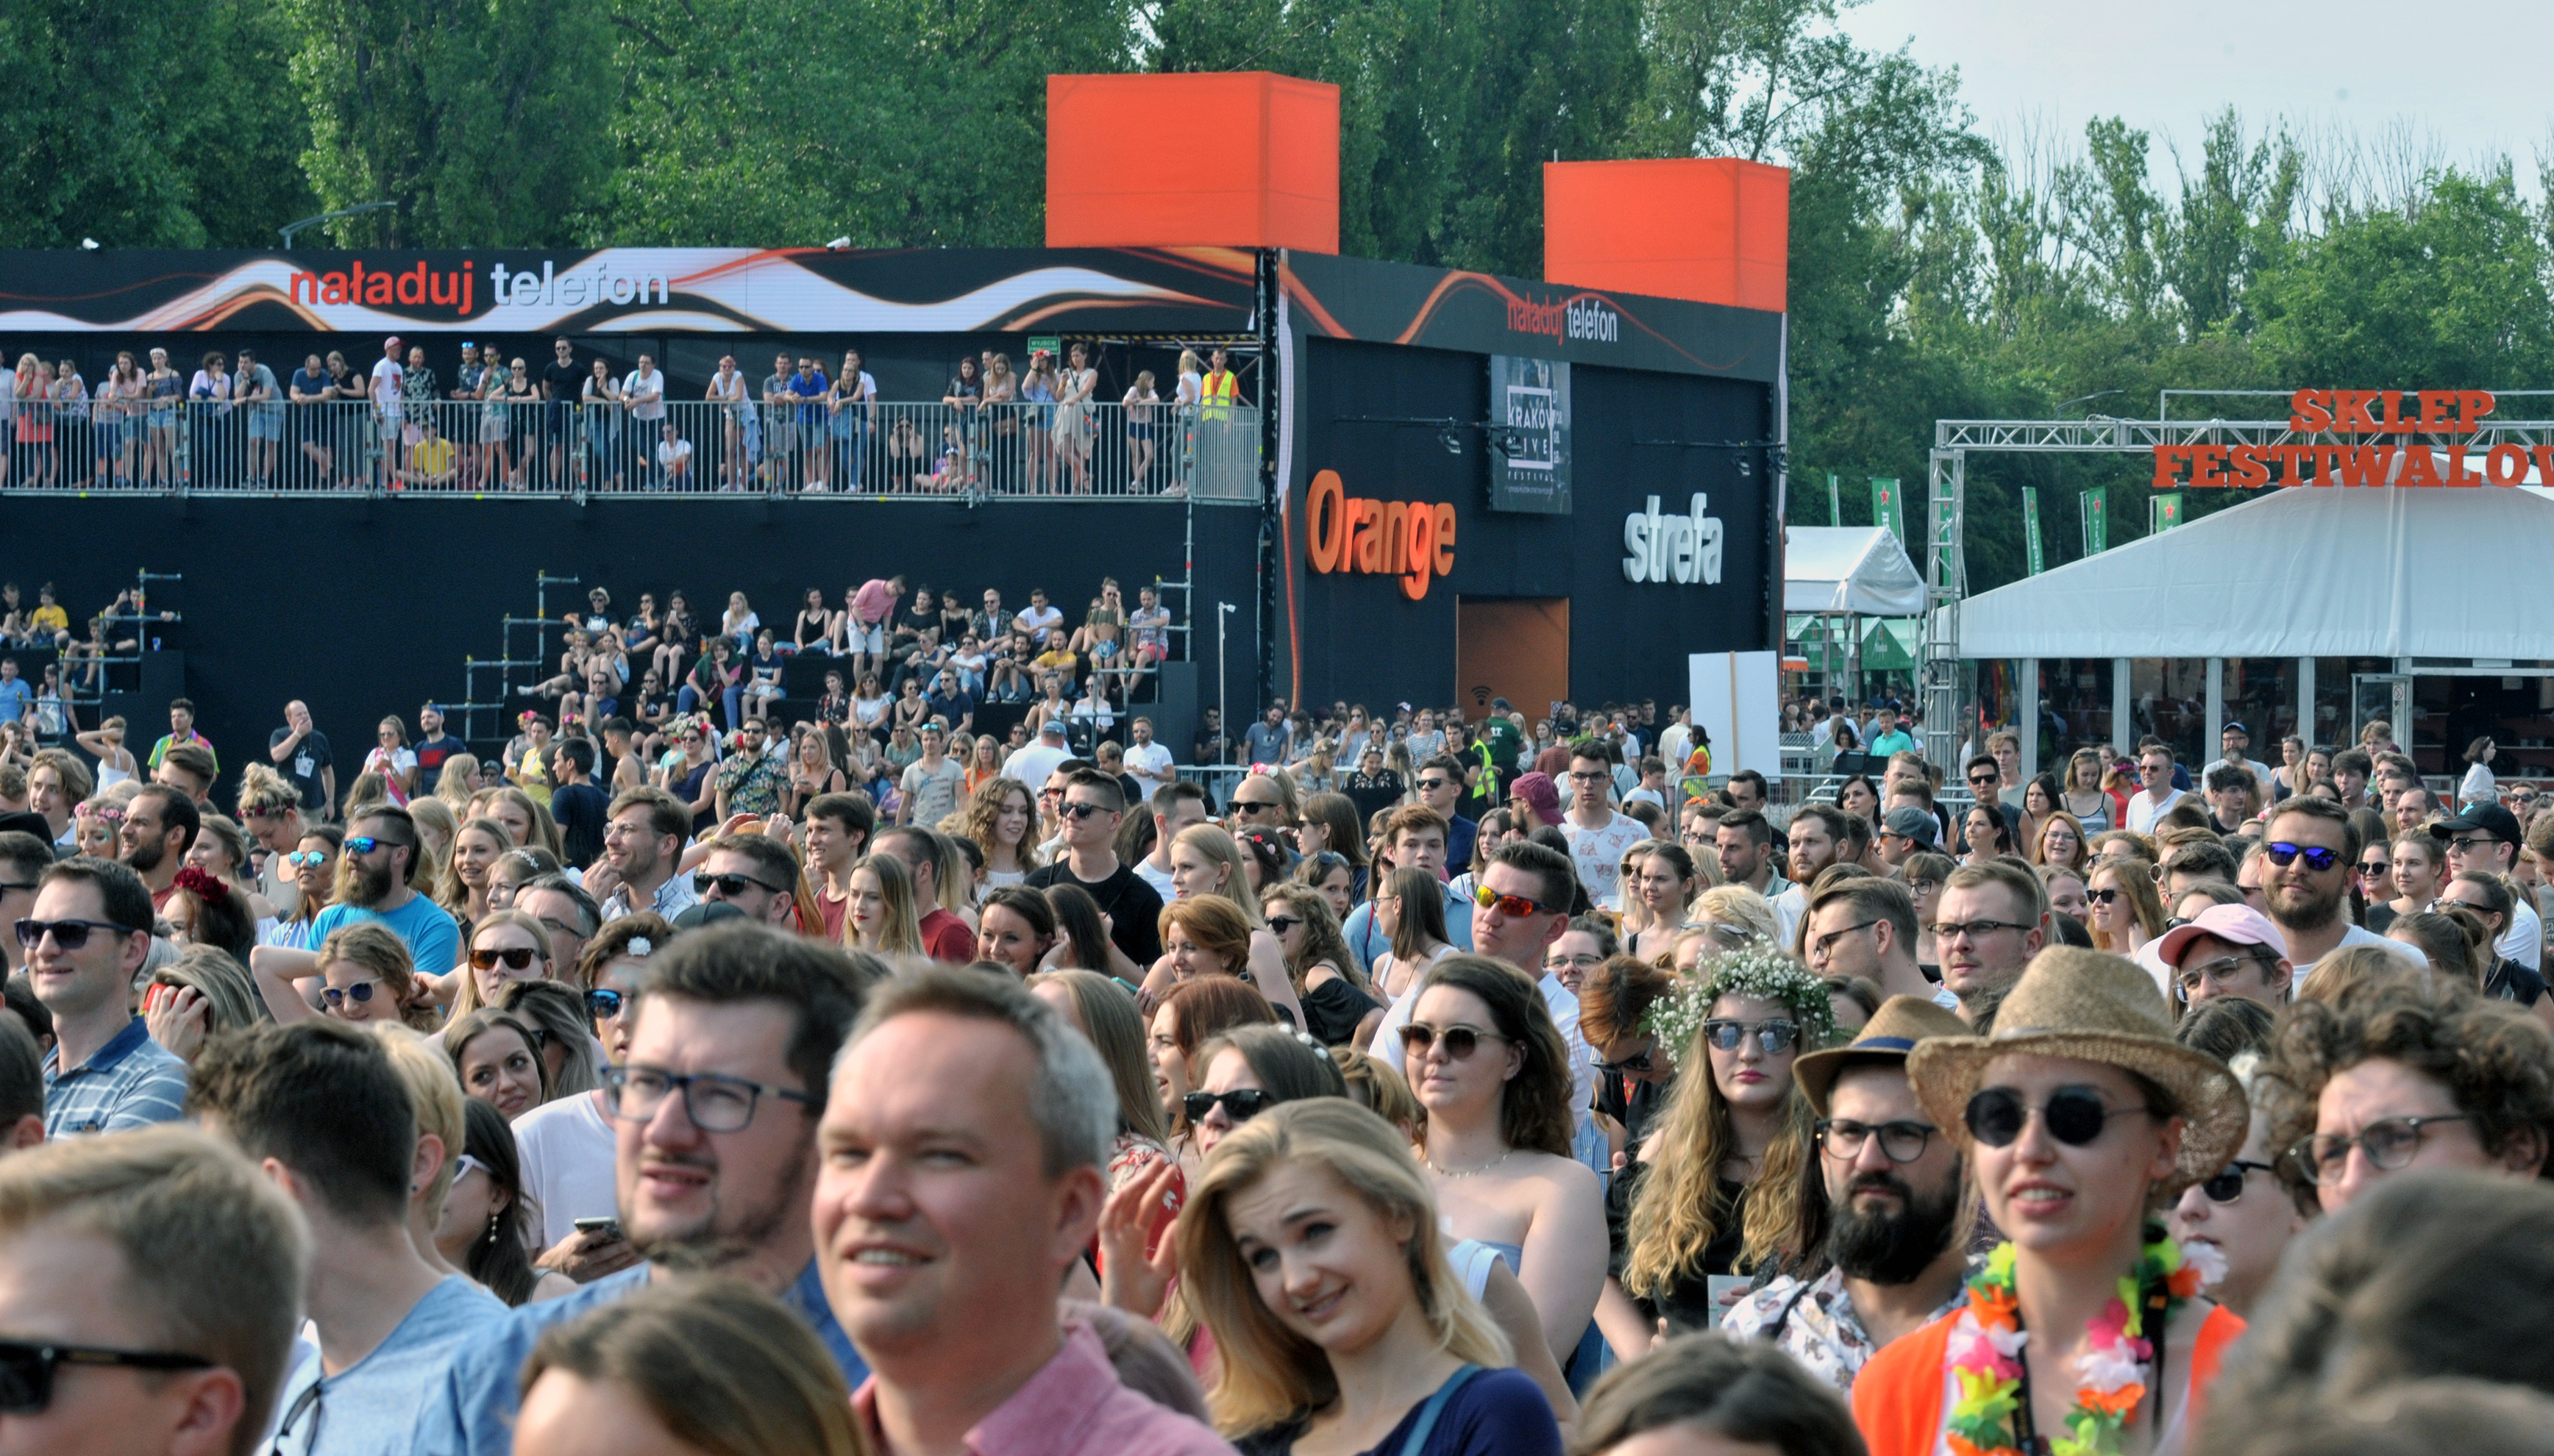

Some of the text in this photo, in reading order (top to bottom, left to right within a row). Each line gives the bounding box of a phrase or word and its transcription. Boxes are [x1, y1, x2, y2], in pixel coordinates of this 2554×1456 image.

[290, 260, 670, 315] naładuj telefon
[1507, 291, 1618, 346] naładuj telefon
[1507, 401, 1556, 429] KRAKÓW
[2289, 388, 2496, 434] SKLEP
[1507, 470, 1554, 482] FESTIVAL
[1305, 468, 1456, 601] Orange
[1623, 492, 1724, 585] strefa
